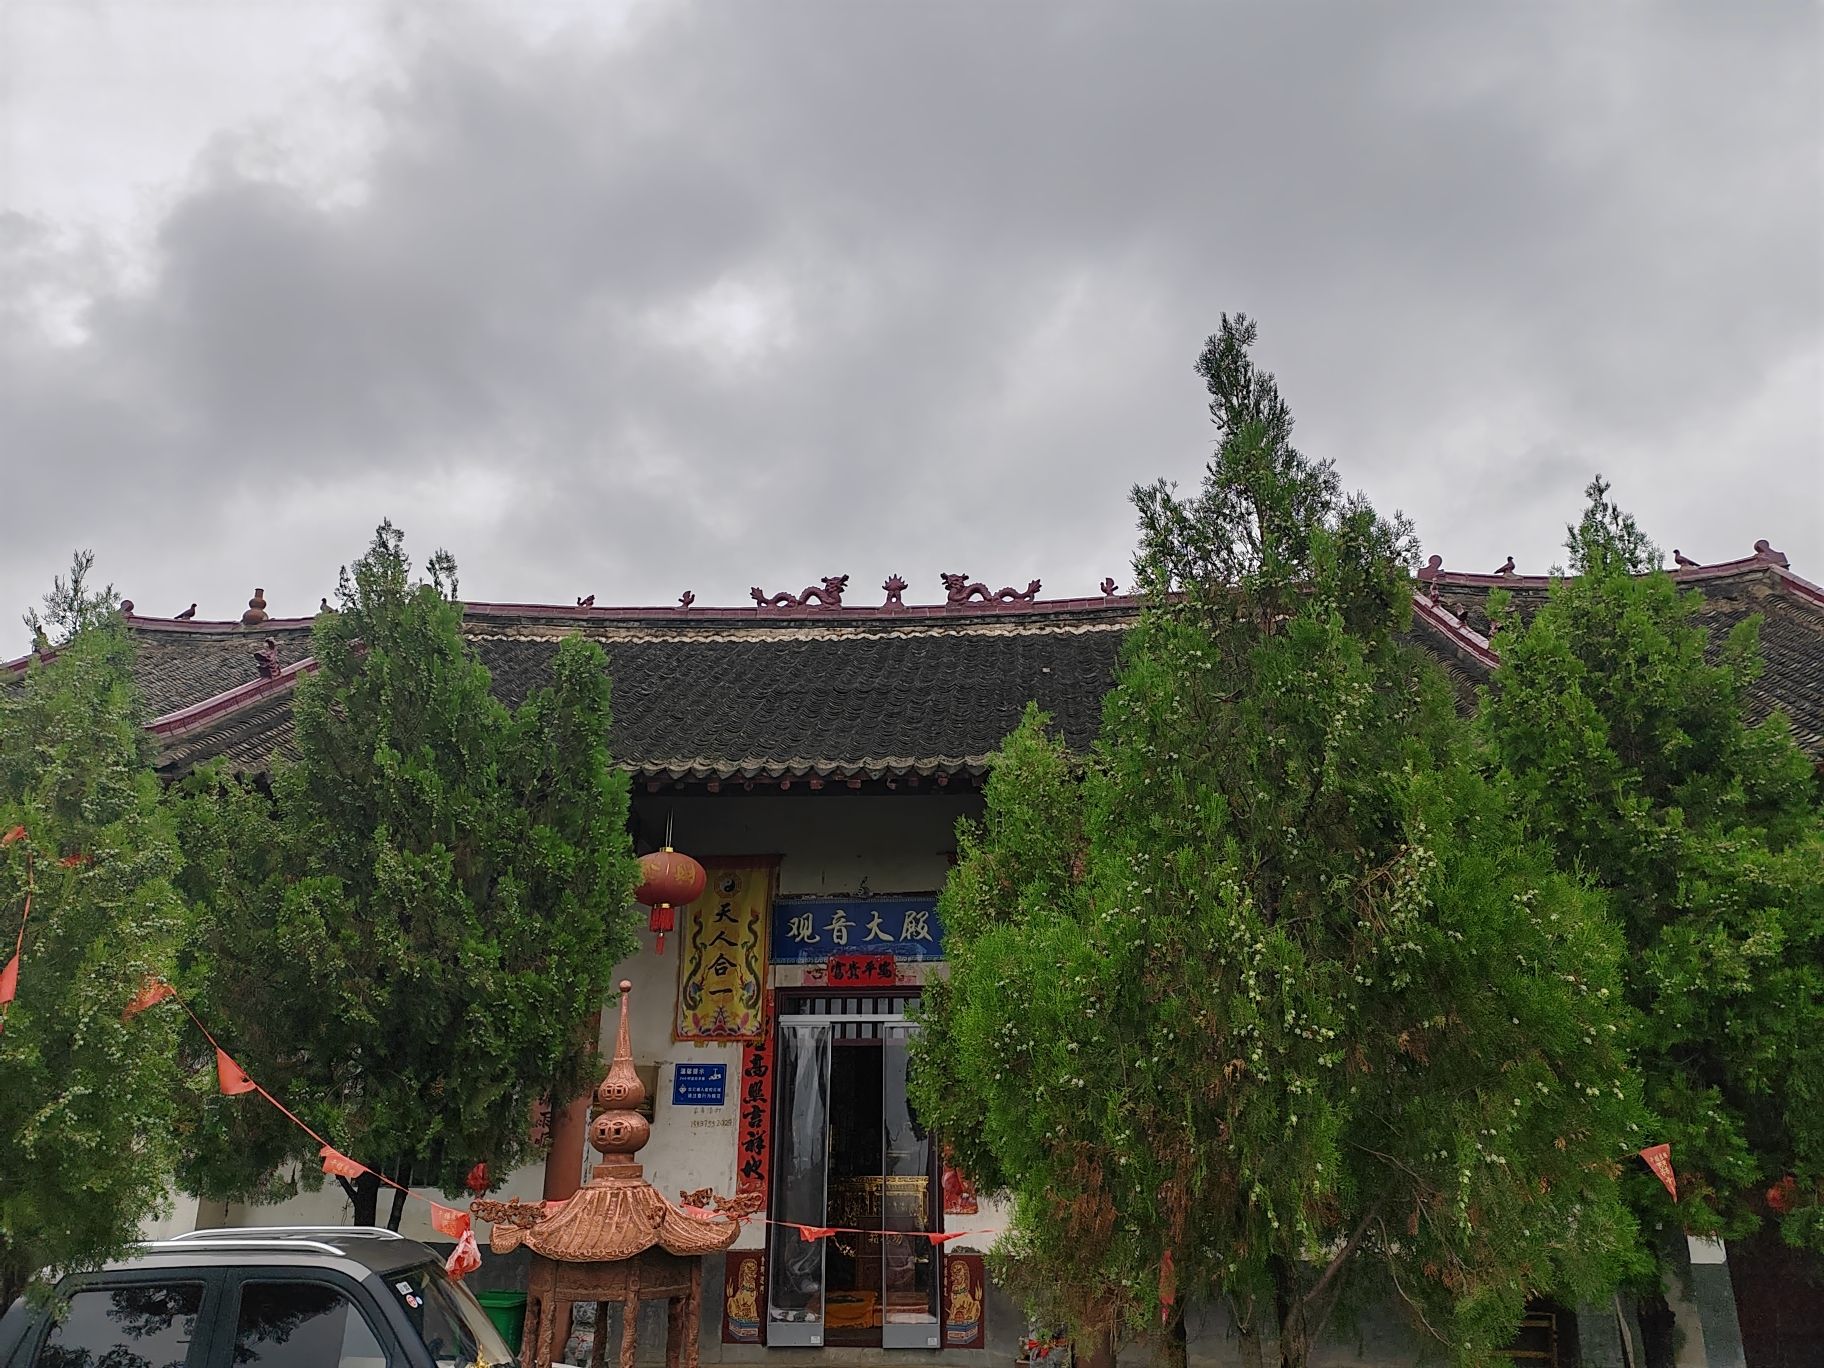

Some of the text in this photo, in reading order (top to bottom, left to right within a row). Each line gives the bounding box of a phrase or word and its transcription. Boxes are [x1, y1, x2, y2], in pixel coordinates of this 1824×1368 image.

[708, 902, 739, 997] 天人合一
[785, 909, 935, 946] 观音大殿
